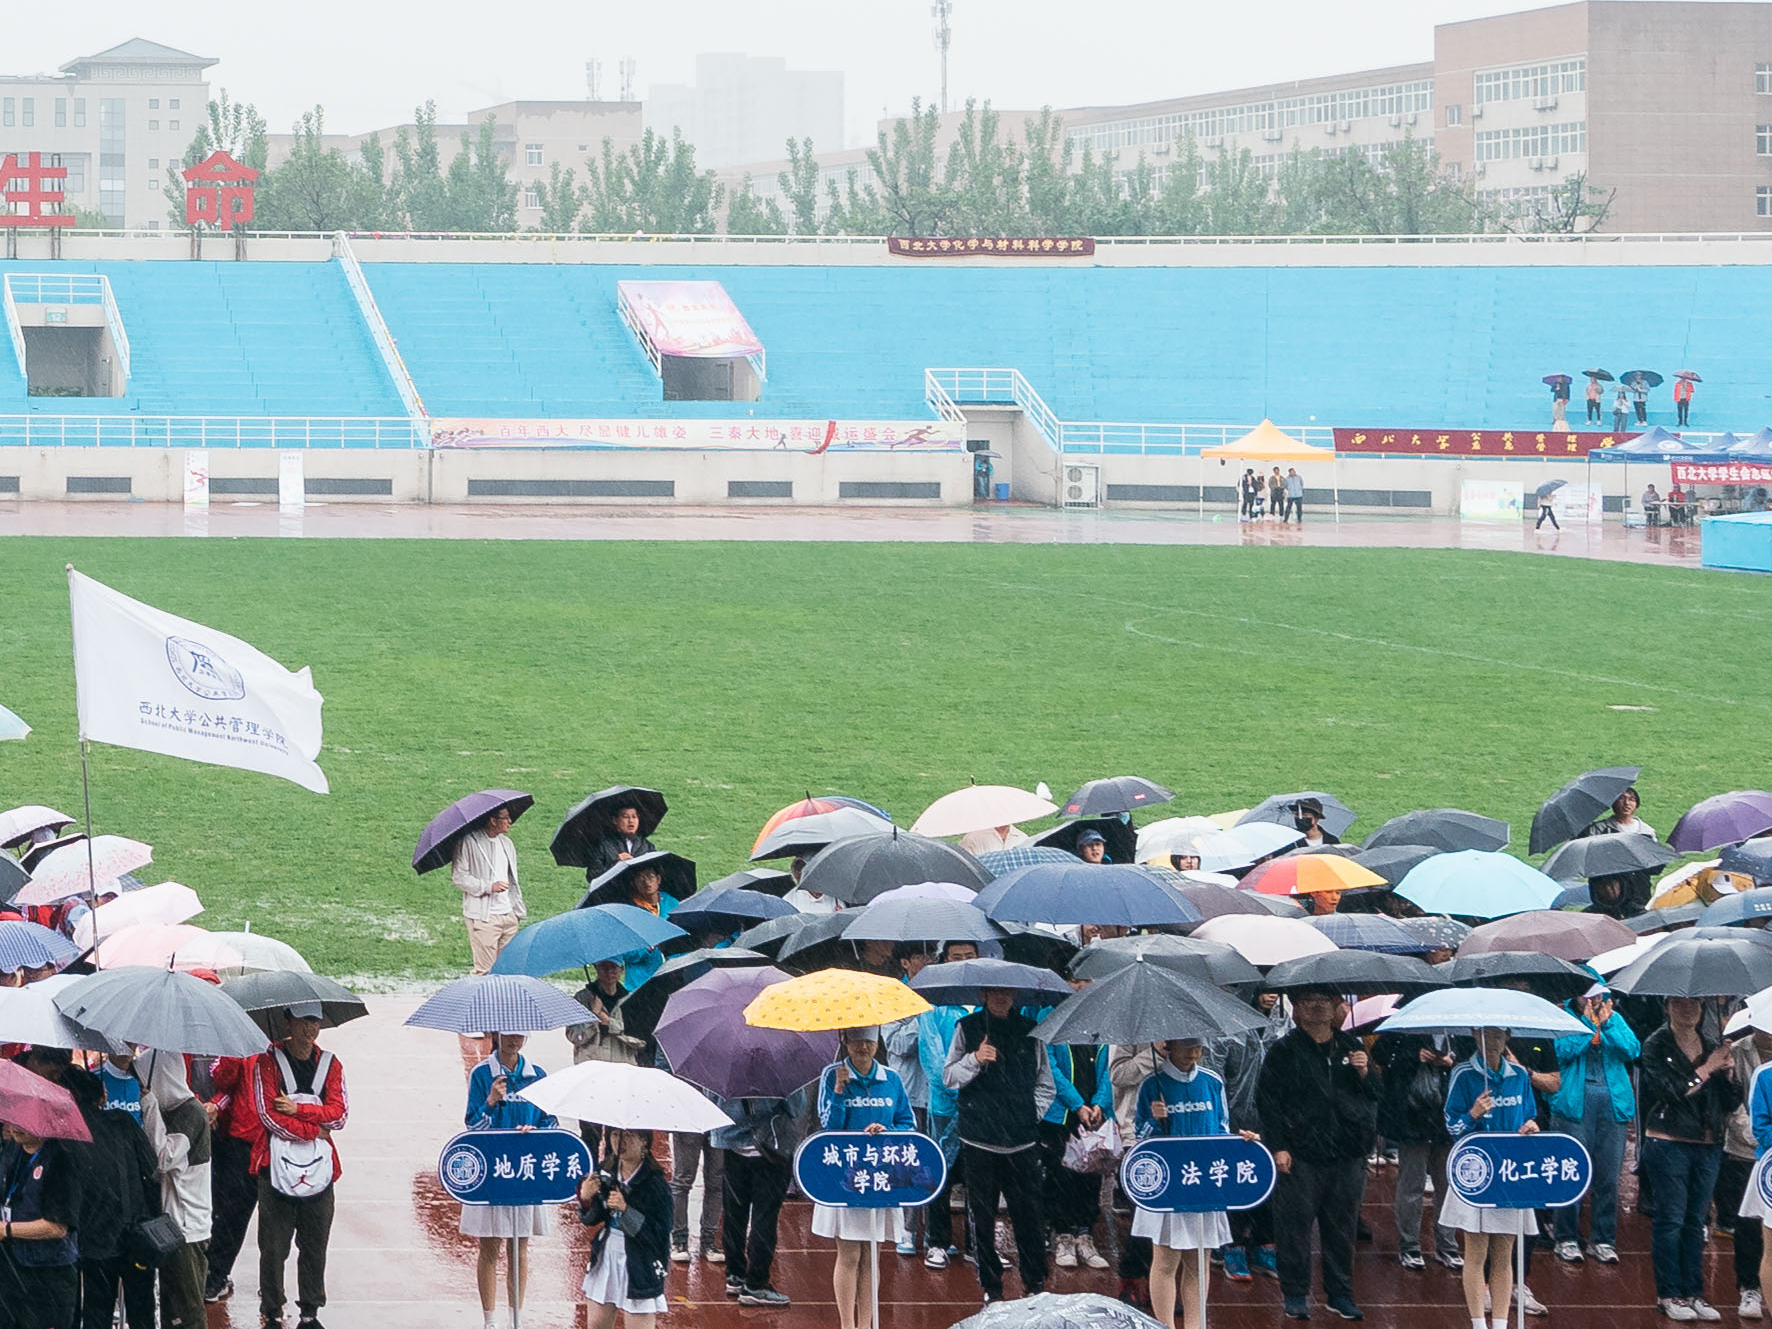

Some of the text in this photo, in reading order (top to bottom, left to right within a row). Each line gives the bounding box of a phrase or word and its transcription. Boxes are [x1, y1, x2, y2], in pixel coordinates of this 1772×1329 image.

[897, 238, 1084, 252] 西北大学化学与材料科学学院
[138, 700, 289, 748] 西北大学公共管理学院
[493, 1151, 583, 1181] 地质学系
[822, 1142, 921, 1168] 城市与环境
[1498, 1155, 1580, 1185] 化工学院
[853, 1169, 891, 1195] 学院
[1181, 1158, 1258, 1188] 法学院
